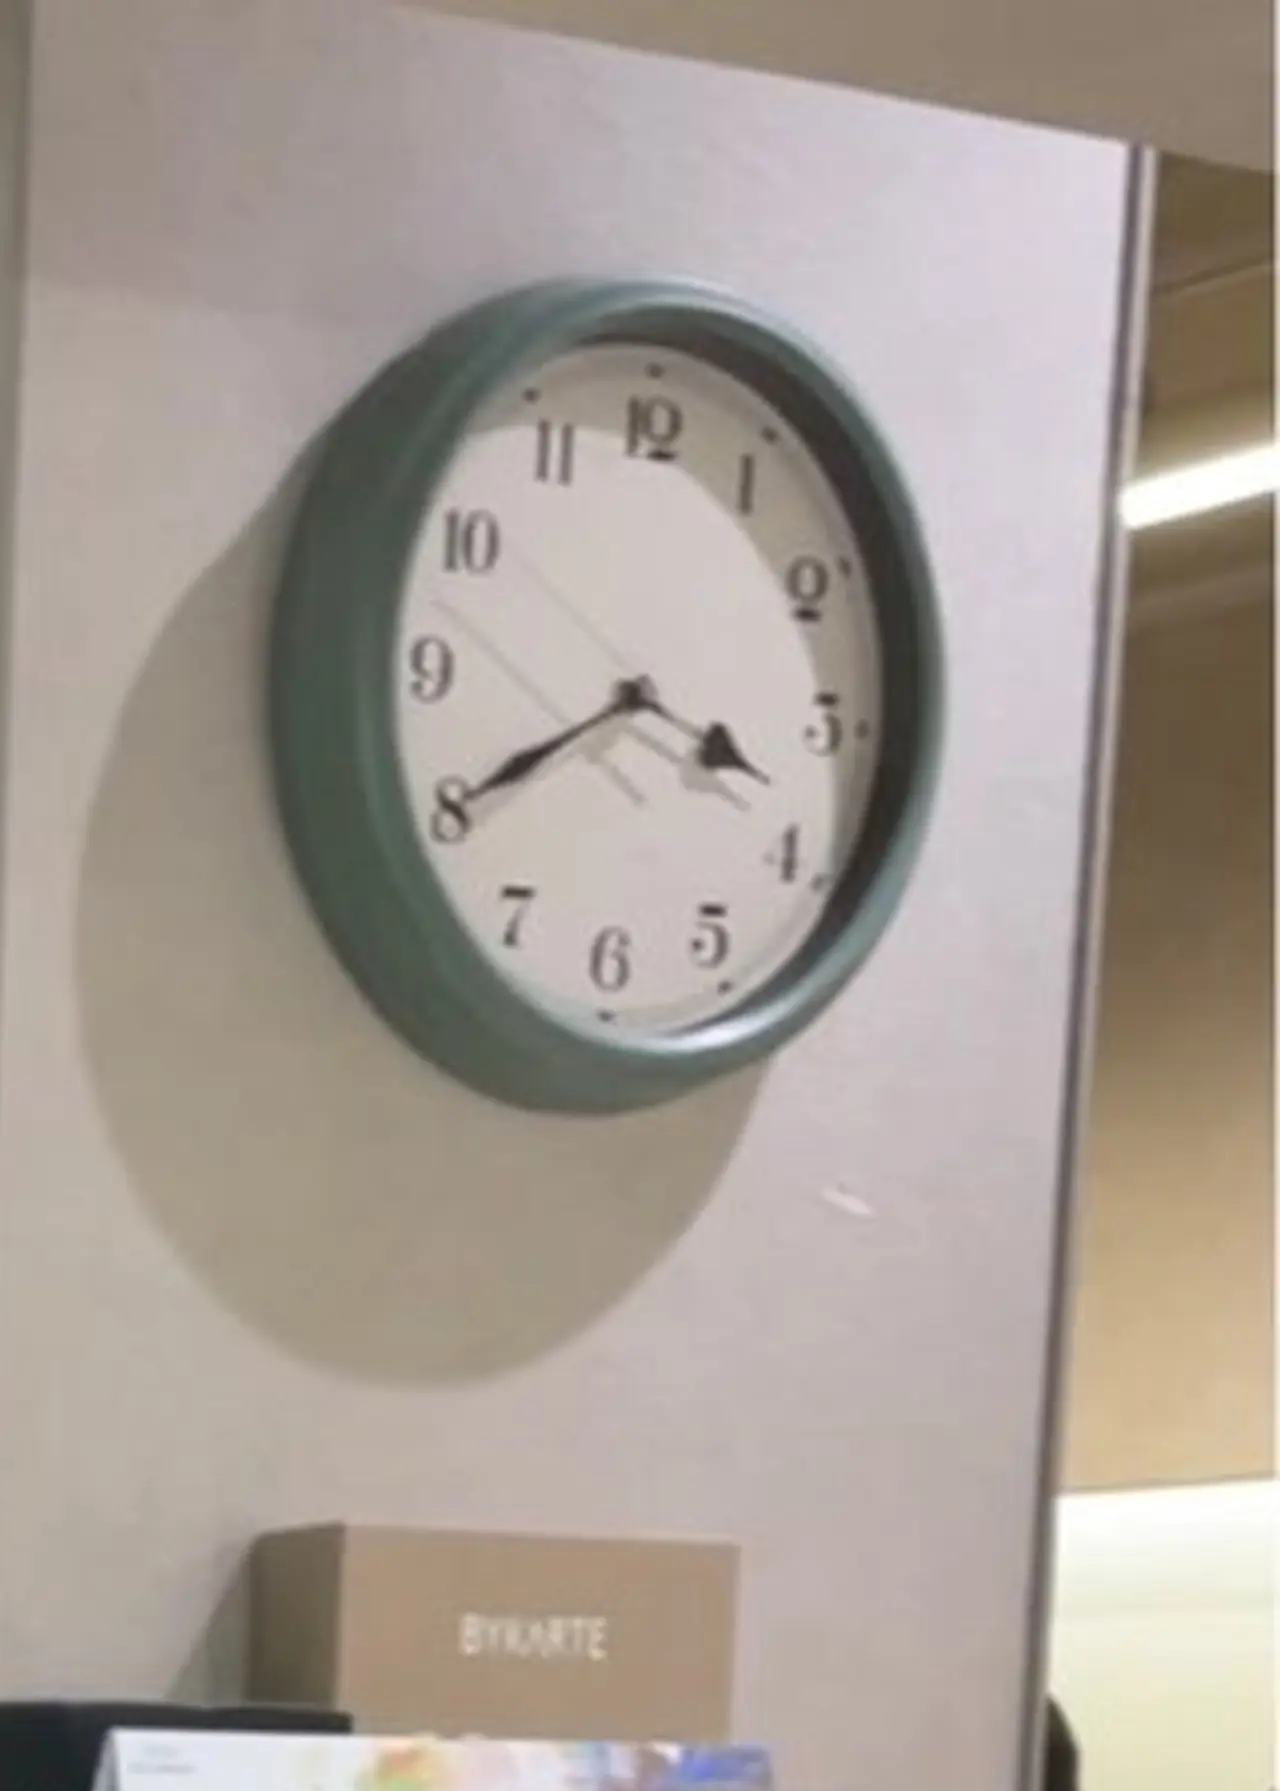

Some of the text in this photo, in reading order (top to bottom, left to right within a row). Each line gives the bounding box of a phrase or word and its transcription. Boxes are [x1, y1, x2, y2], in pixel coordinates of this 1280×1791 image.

[534, 419, 574, 485] 11
[627, 396, 682, 461] 12
[737, 455, 756, 515] 1
[443, 509, 500, 575] 10
[788, 556, 829, 622] 2
[409, 636, 454, 702] 9
[805, 693, 843, 757] 3
[429, 776, 472, 844] 8
[765, 823, 801, 883] 4
[500, 885, 536, 947] 7
[690, 905, 730, 969] 5
[590, 928, 630, 992] 6
